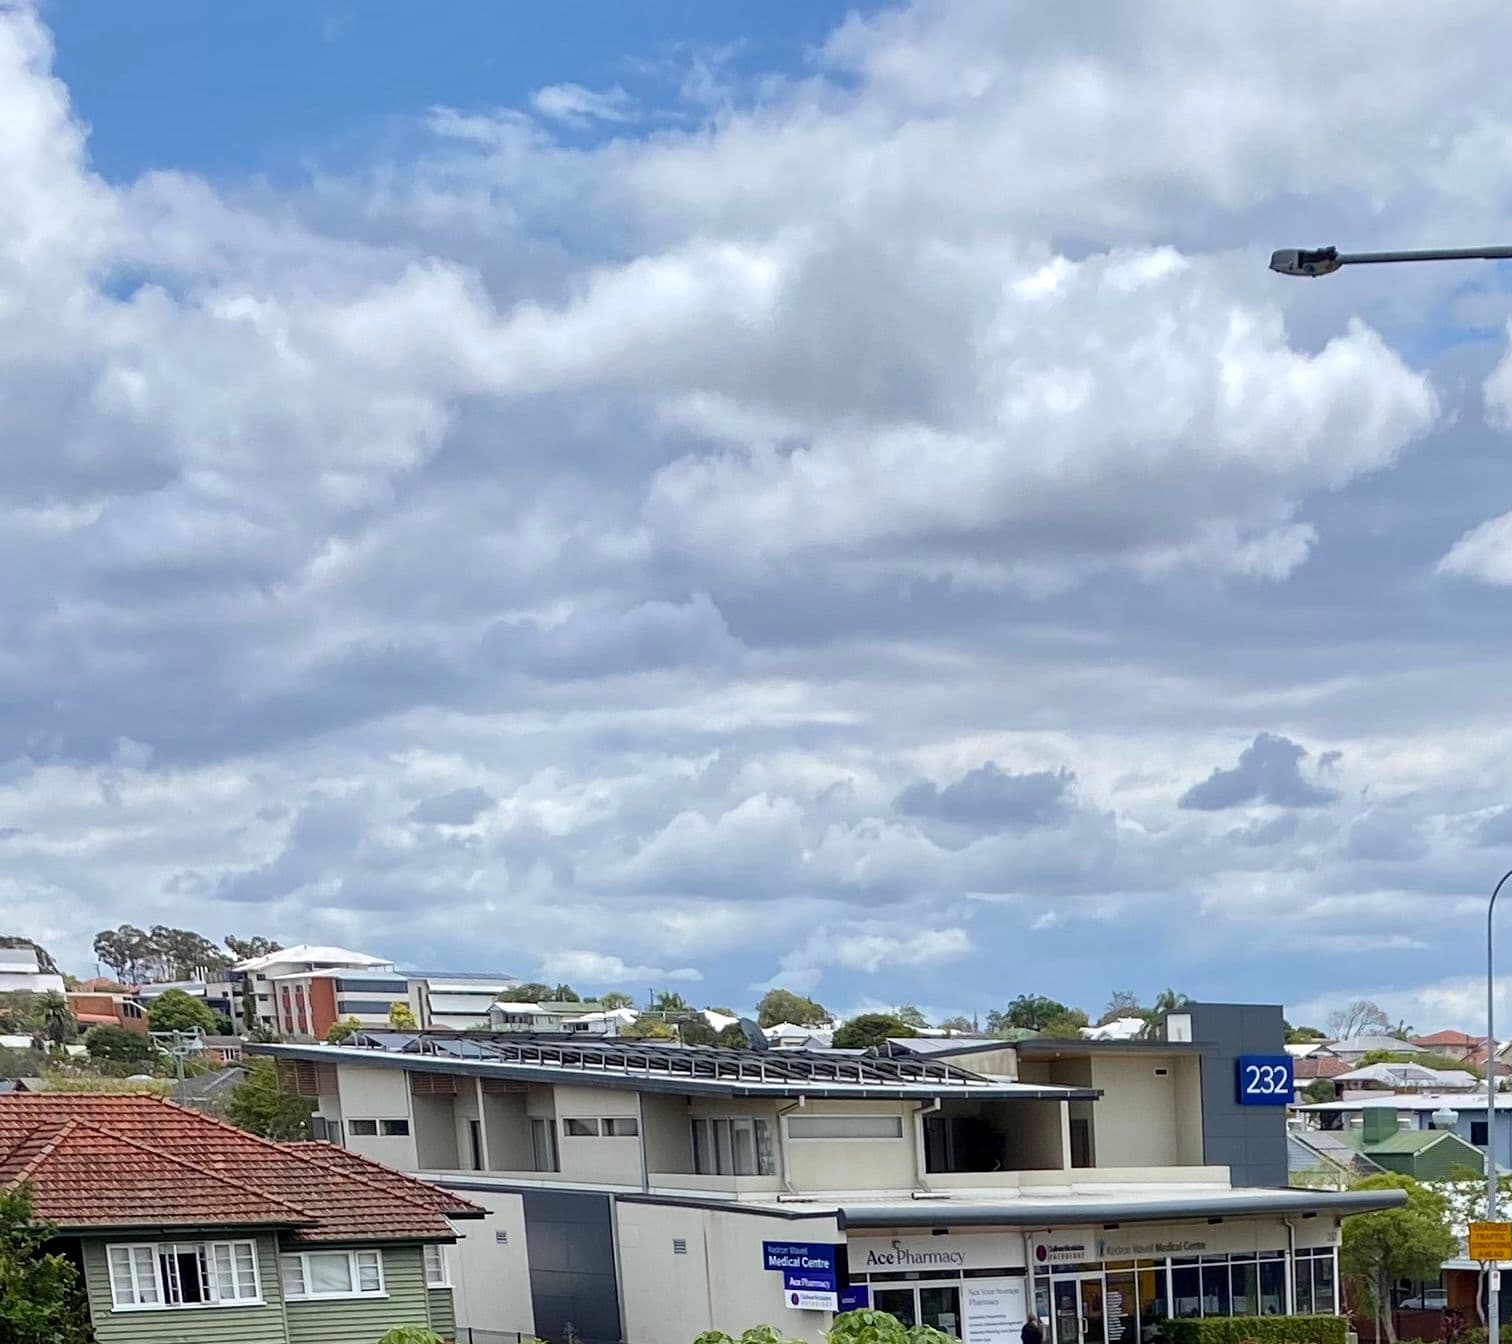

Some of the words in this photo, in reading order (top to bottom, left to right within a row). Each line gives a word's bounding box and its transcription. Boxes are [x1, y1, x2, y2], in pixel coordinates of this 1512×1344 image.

[1246, 1065, 1289, 1094] 232
[768, 1256, 801, 1267] Medical
[801, 1257, 830, 1269] Centre
[866, 1249, 895, 1266] Ace
[896, 1249, 965, 1266] Pharmacy
